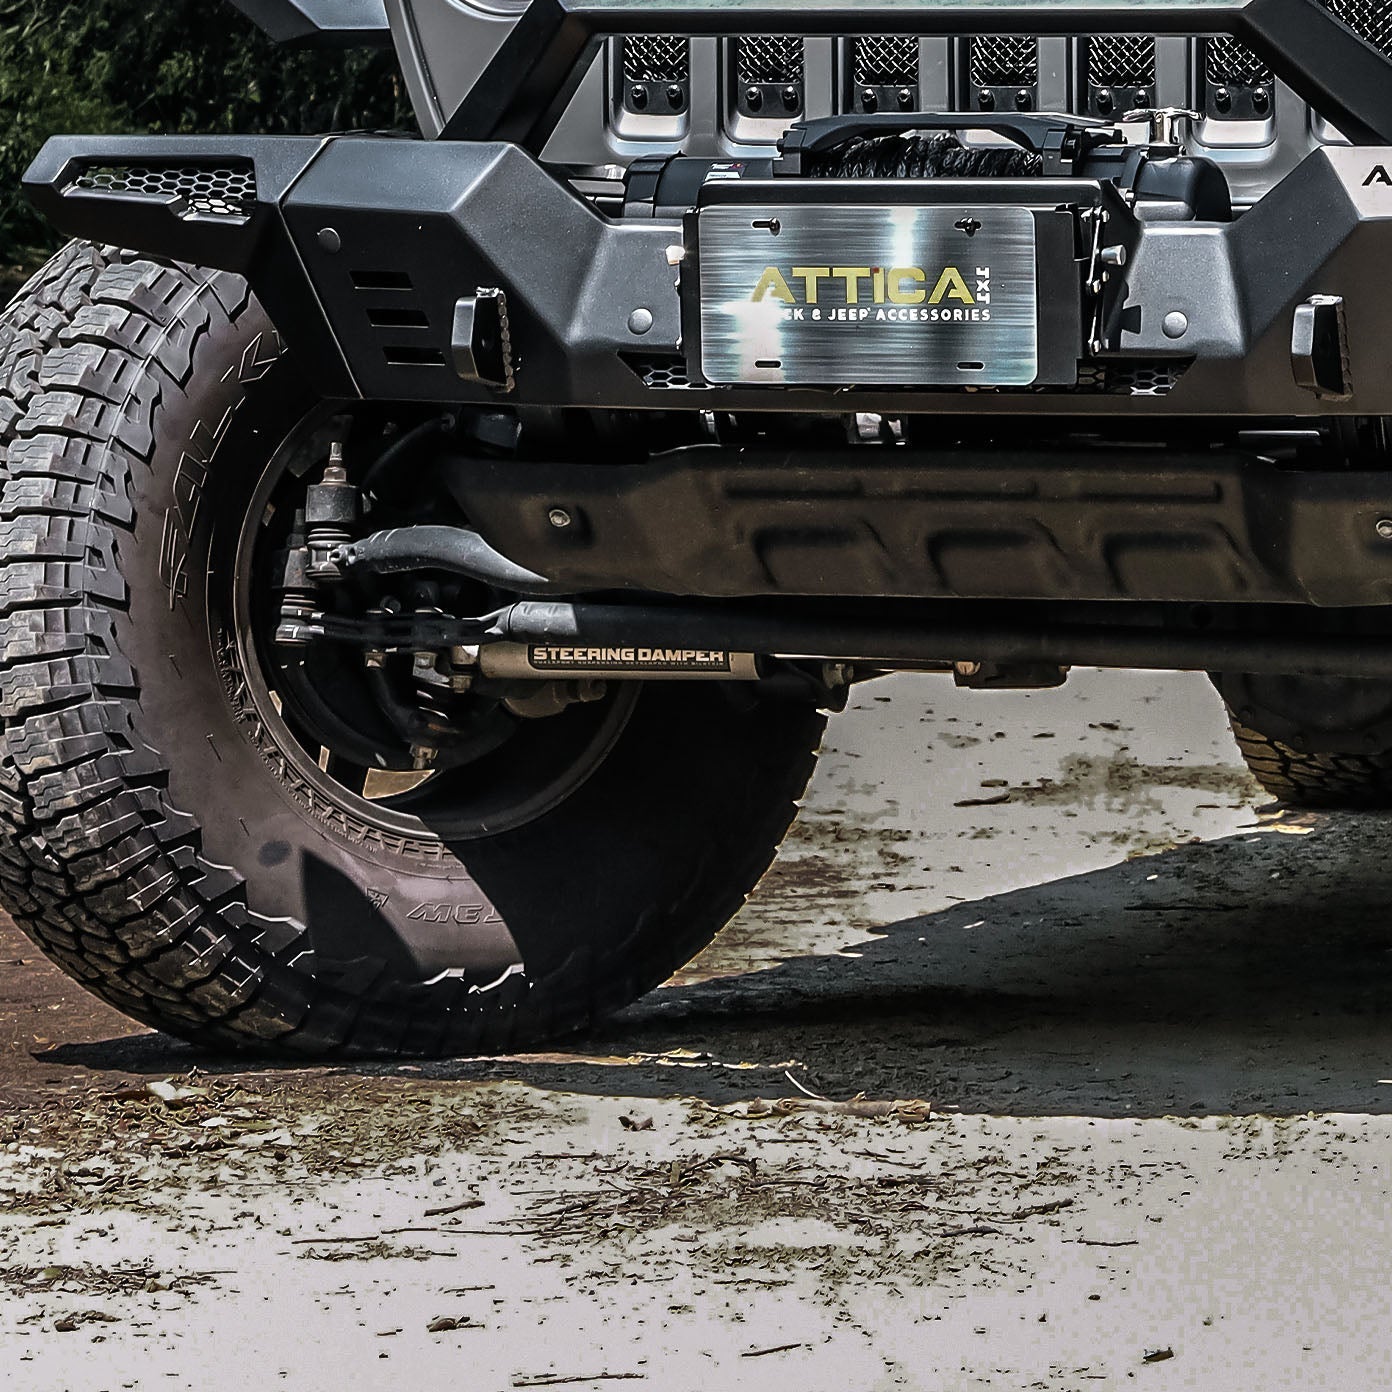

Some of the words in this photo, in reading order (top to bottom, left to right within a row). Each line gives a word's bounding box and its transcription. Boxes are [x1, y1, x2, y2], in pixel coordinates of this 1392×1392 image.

[751, 266, 976, 305] ATTICA
[976, 266, 991, 305] 4X4
[876, 307, 991, 321] ACCESSORIES
[533, 647, 635, 662] STEERING
[637, 648, 724, 663] DAMPER
